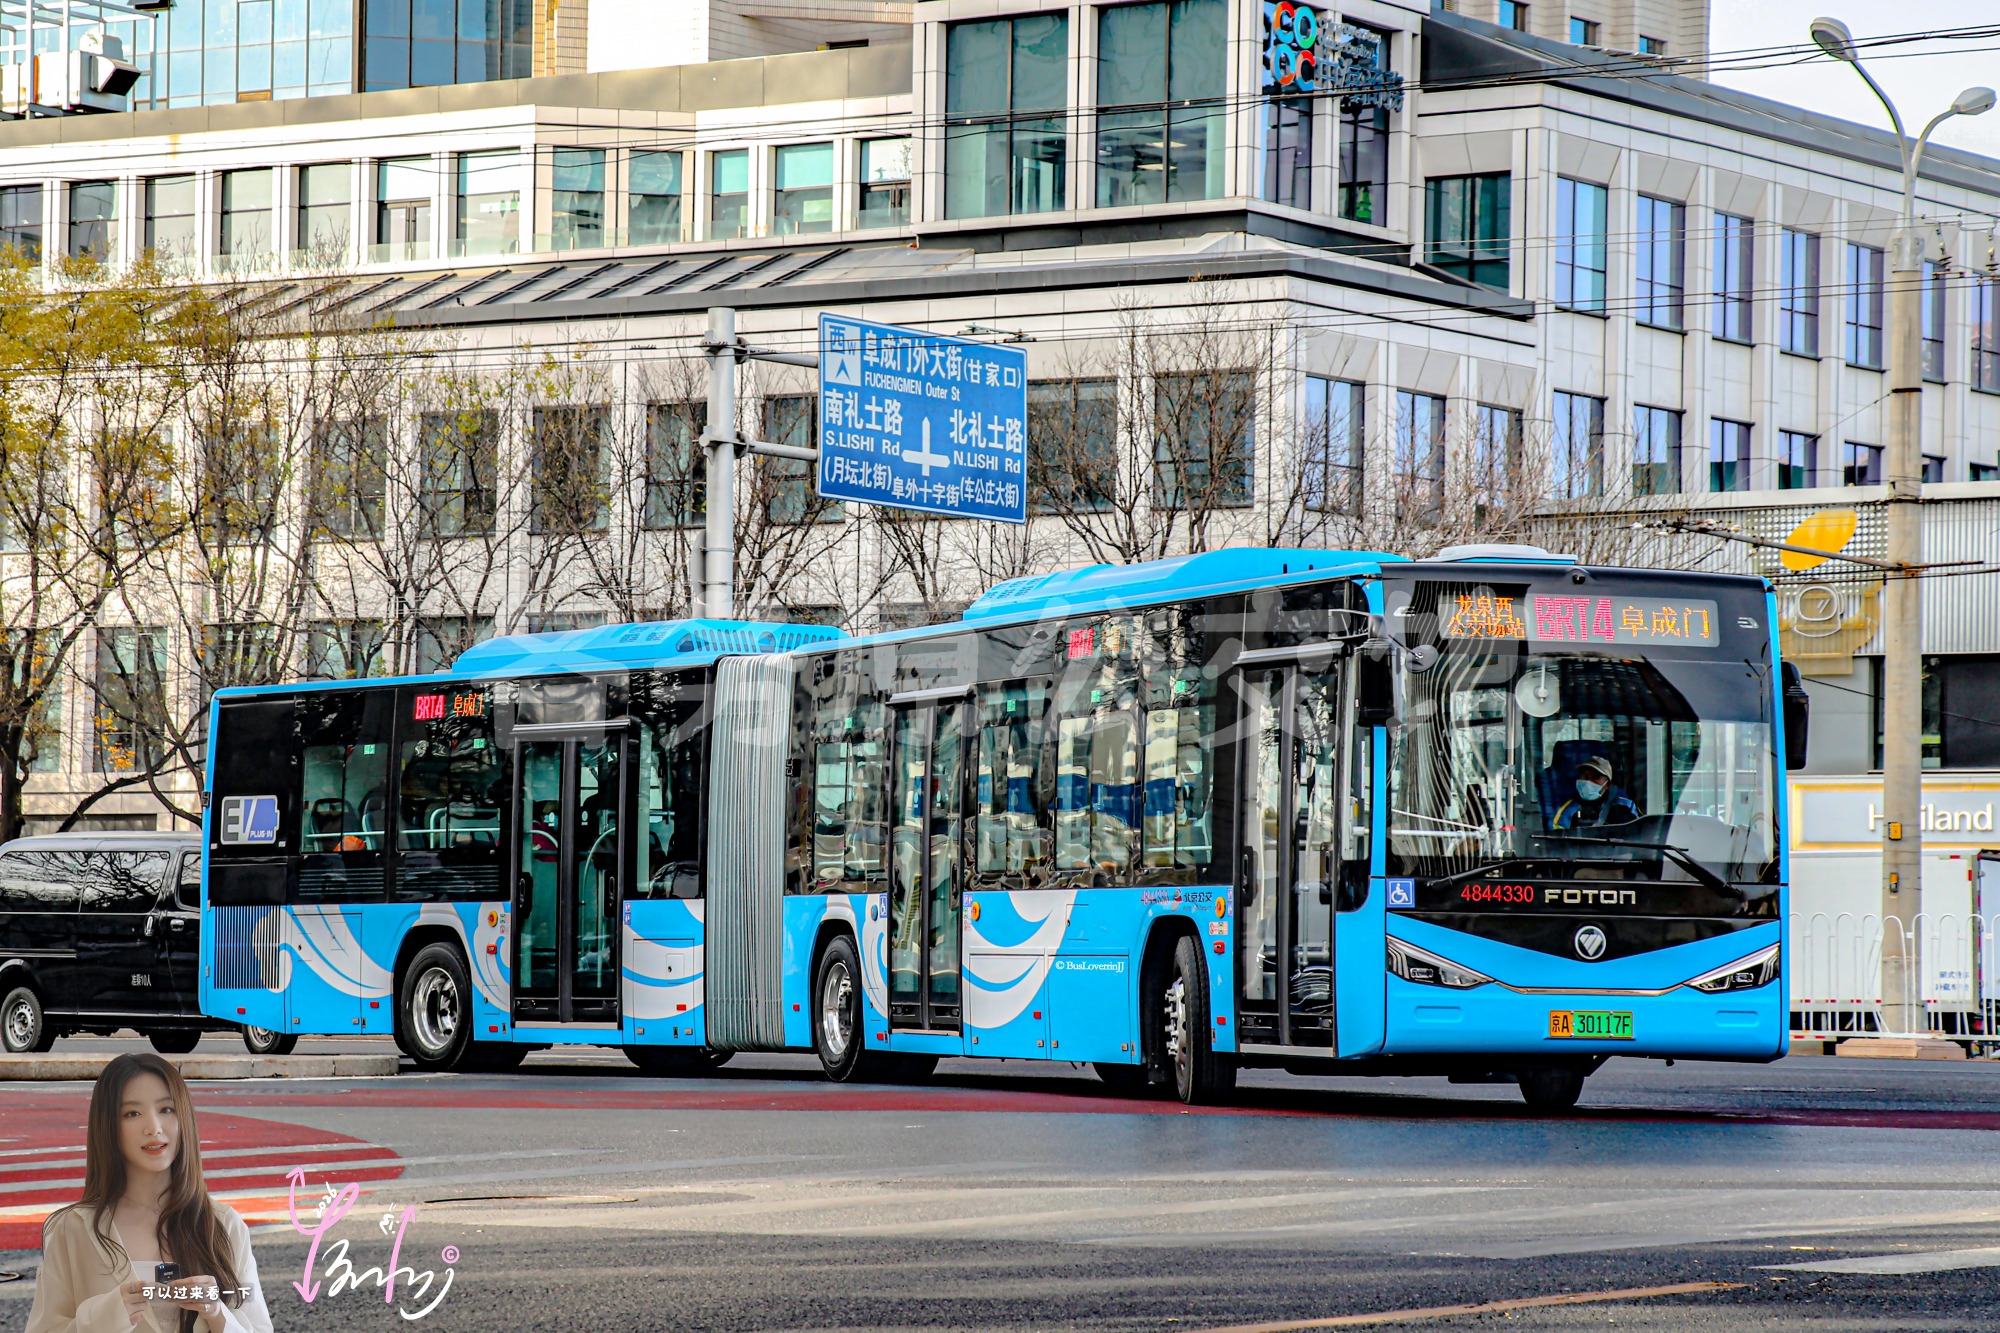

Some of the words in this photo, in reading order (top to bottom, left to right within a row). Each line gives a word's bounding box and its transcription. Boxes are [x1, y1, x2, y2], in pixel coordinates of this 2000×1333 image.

[829, 325, 846, 355] 西
[847, 340, 857, 356] W
[864, 371, 922, 396] FUCHENGMEN
[925, 386, 948, 400] Outer
[951, 389, 961, 402] St
[824, 388, 904, 436] 南礼士路
[825, 430, 875, 453] S.LISHI
[882, 440, 900, 456] Rd
[949, 408, 1024, 454] 北礼士路
[824, 456, 892, 491] (月坛北街)
[953, 450, 999, 471] N.LISHI
[1005, 459, 1021, 474] Rd
[891, 476, 960, 508] 阜外十字街
[960, 476, 1019, 509] (车公庄大街)
[1453, 594, 1514, 618] 龙泉西
[1534, 596, 1615, 642] BRT4
[1619, 605, 1711, 639] 阜成门
[414, 694, 446, 721] BRT4
[453, 693, 484, 717] 阜成门
[1868, 802, 1993, 832] Hiland
[250, 830, 273, 838] PLUG-IN
[1460, 884, 1534, 903] 4844330
[1544, 889, 1636, 905] FOTON
[1552, 1014, 1570, 1033] 京A
[1577, 1014, 1631, 1034] 30117F
